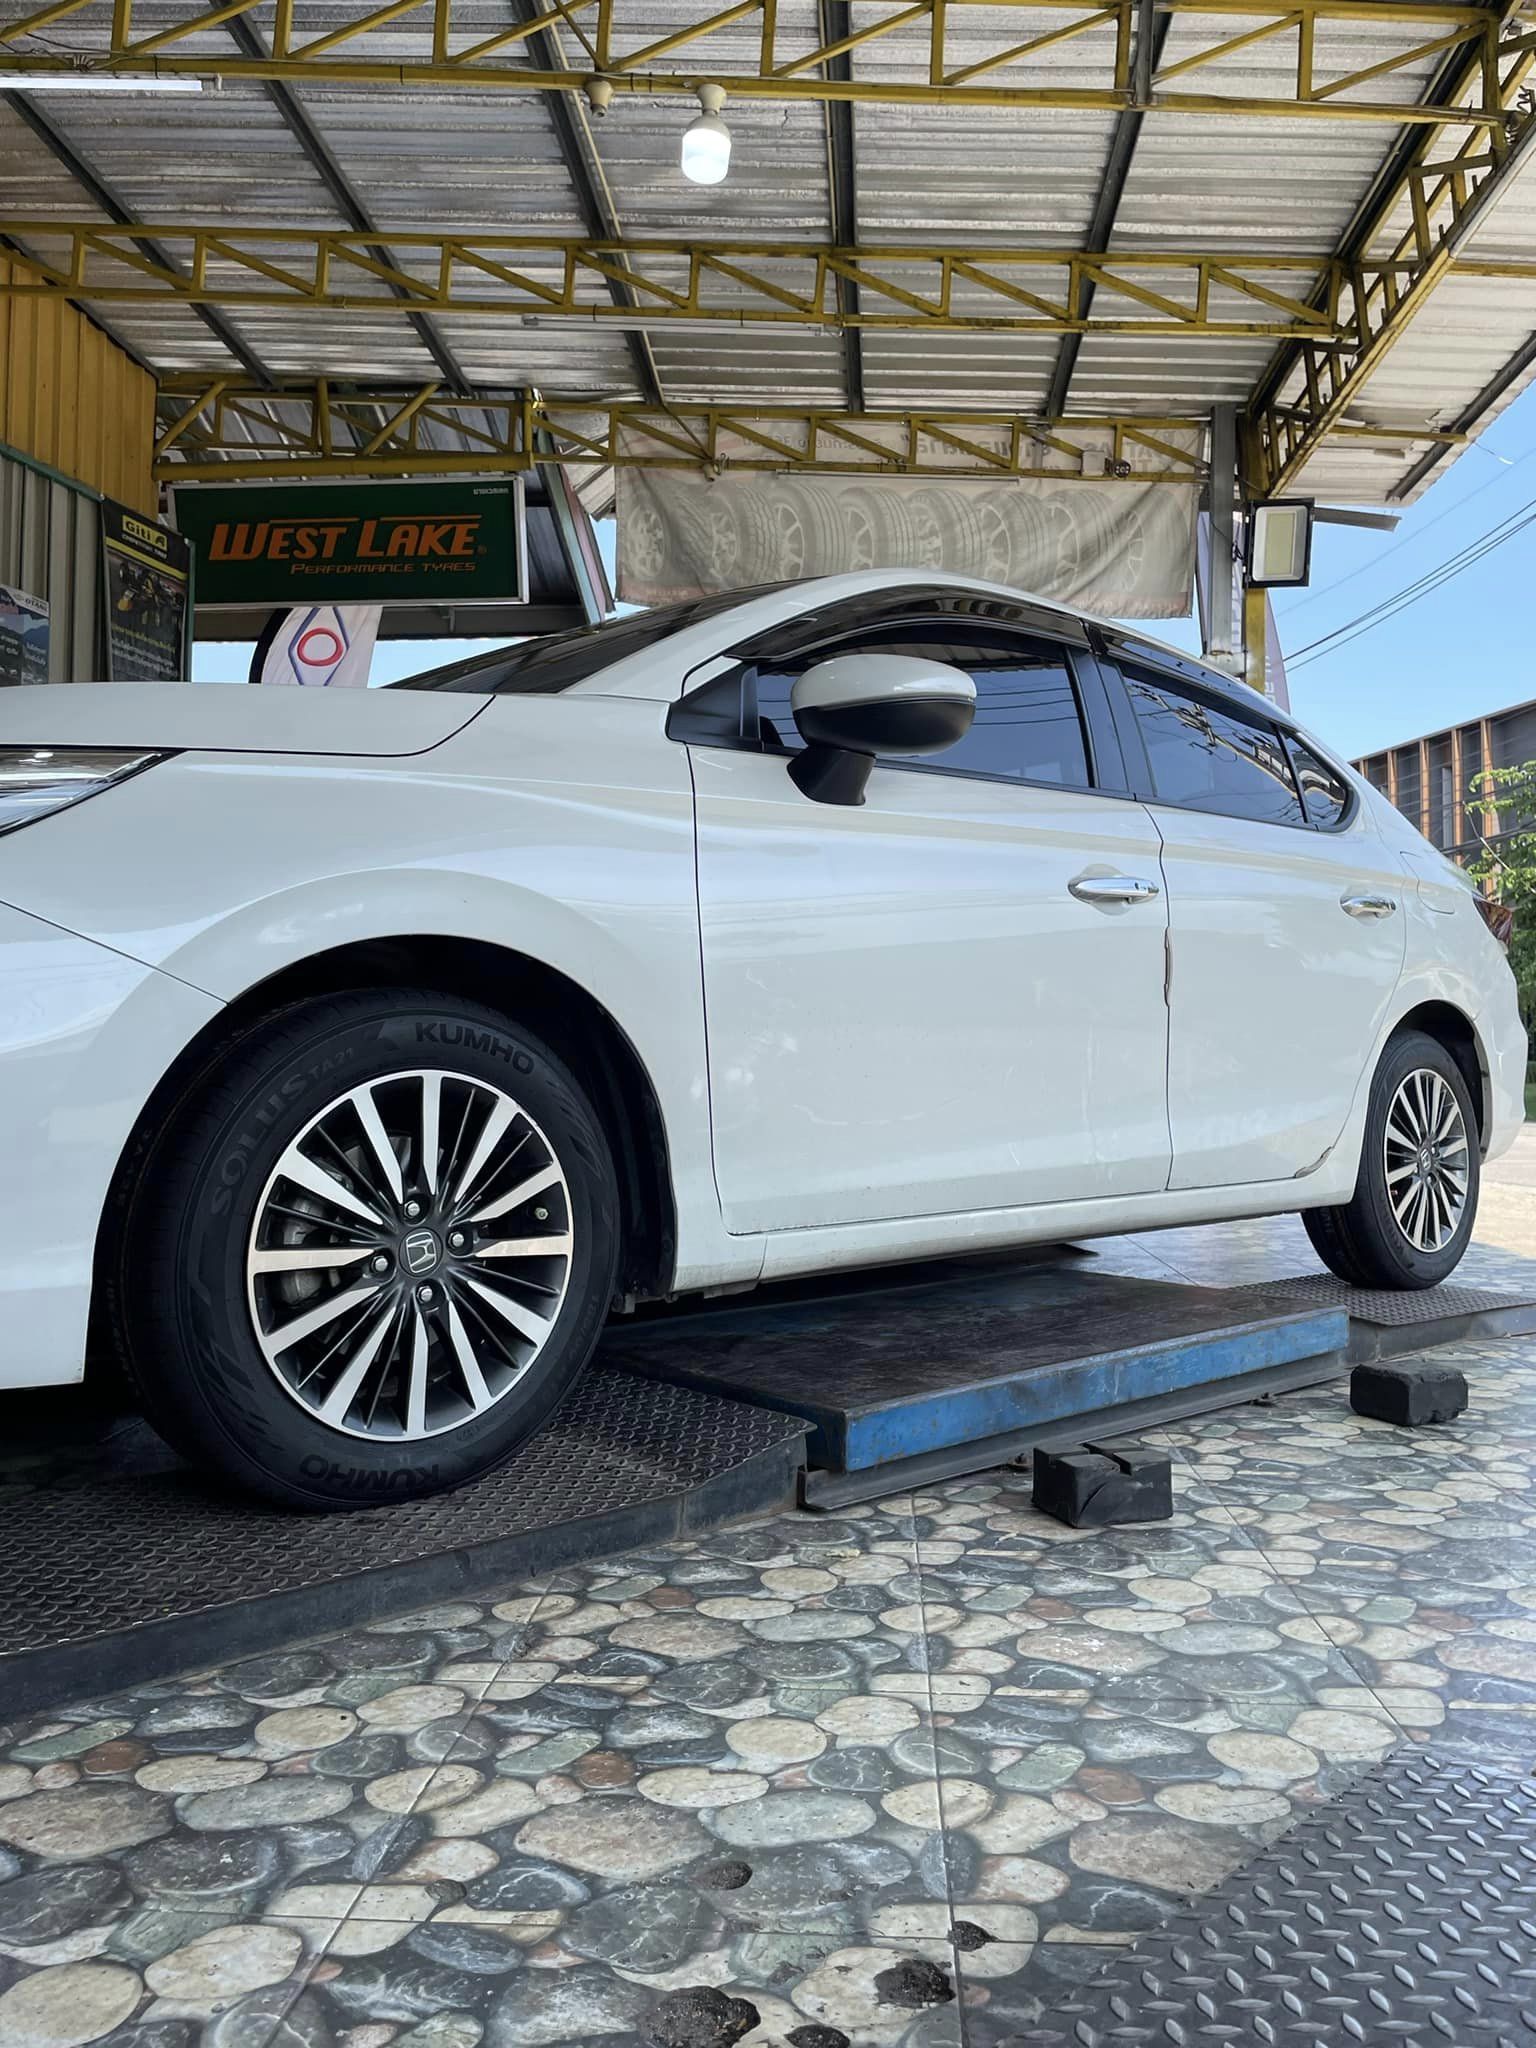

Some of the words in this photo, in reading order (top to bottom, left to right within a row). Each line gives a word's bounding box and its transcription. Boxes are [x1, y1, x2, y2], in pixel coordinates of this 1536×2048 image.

[125, 520, 151, 541] Giti
[208, 520, 350, 561] WEST
[356, 519, 480, 558] LAKE
[291, 563, 415, 575] PERFORMANCE
[422, 561, 476, 574] TYRES
[415, 1021, 536, 1076] KUMHO
[211, 1073, 313, 1218] SOLUS
[299, 1453, 439, 1490] KUMHO
